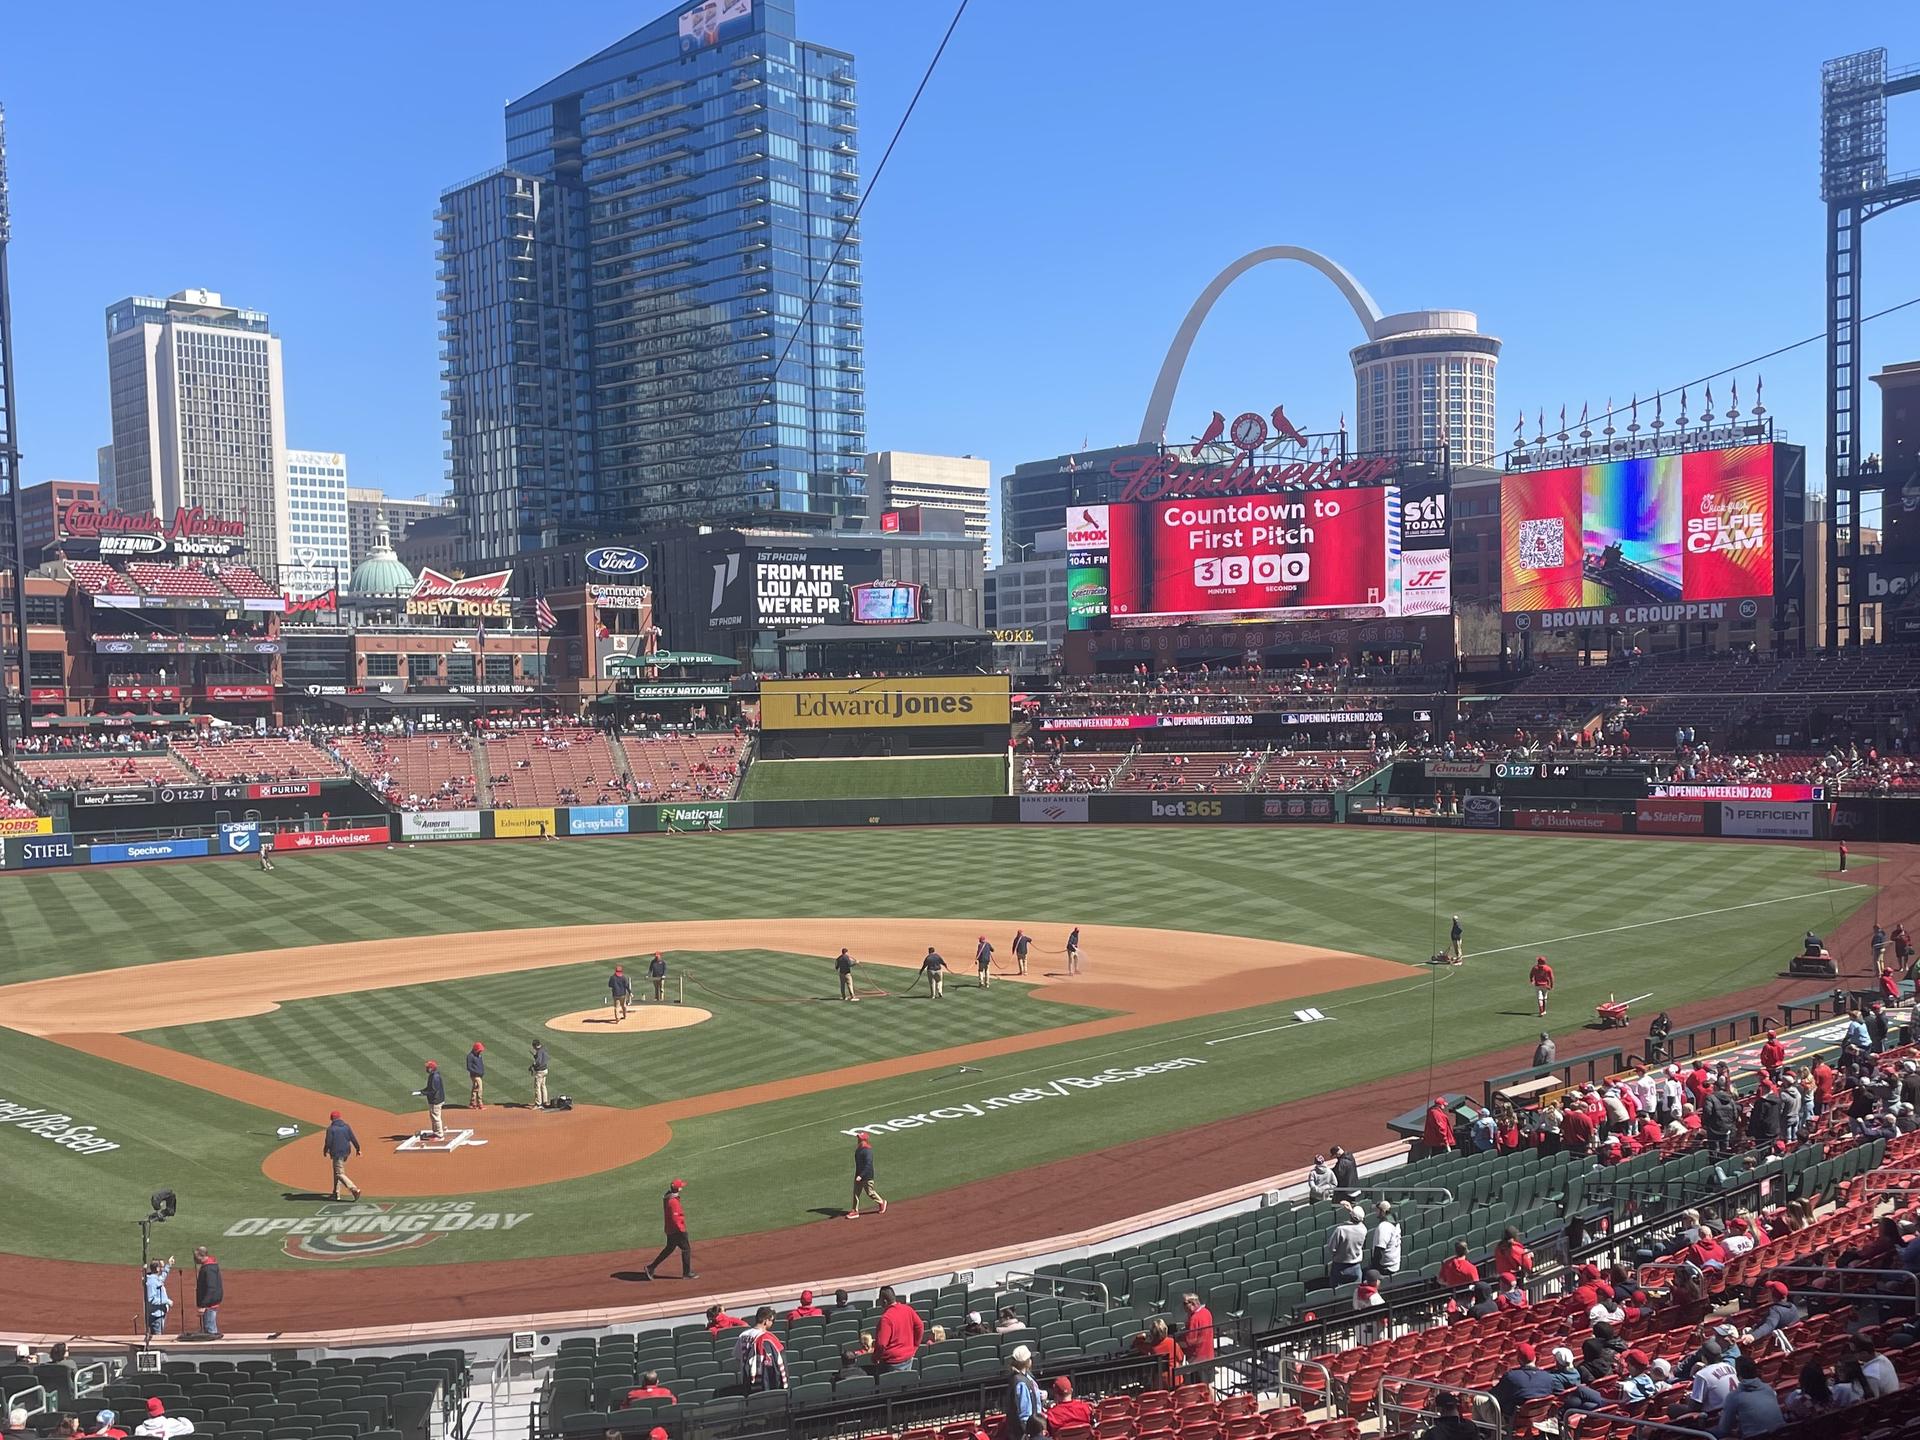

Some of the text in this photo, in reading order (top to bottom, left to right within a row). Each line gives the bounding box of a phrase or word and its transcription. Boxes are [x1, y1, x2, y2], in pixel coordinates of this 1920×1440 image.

[1528, 426, 1746, 464] WORLD CHAMPIONS
[1110, 452, 1399, 501] Budweiser
[1164, 499, 1341, 527] Countdown to
[1404, 494, 1445, 521] stl
[64, 501, 244, 540] Cardinals Nation
[1404, 520, 1445, 530] TODAY
[1687, 513, 1763, 533] SELFIE
[1068, 530, 1107, 542] KMOX
[1188, 523, 1315, 550] First Pitch
[1687, 527, 1763, 554] CAM
[100, 537, 155, 550] HOFFMANN
[174, 542, 230, 555] ROOFTOP
[599, 549, 637, 570] Ford
[757, 552, 807, 562] 1ST PHORM
[1069, 556, 1108, 565] 104.1 FM
[757, 564, 844, 581] FROM THE
[411, 579, 509, 599] Budweiser
[591, 584, 649, 599] Community
[758, 580, 832, 597] LOU AND
[596, 595, 642, 607] America
[757, 597, 814, 614] WE'RE
[406, 601, 512, 617] BREW HOUSE
[1071, 606, 1108, 615] POWER
[1541, 603, 1723, 628] BROWN & CROUPPEN
[986, 629, 1034, 643] MOKE
[676, 686, 725, 697] NATIONAL
[794, 689, 974, 719] Edward Jones
[1054, 718, 1130, 728] OPENING WEEKEND 2026
[1173, 715, 1253, 726] OPENING WEEKEND 2026
[1299, 712, 1383, 723] OPENING WEEKEND 2026
[1510, 766, 1535, 777] 12:37
[177, 790, 204, 800] 12:37
[271, 785, 307, 794] PURINA
[1669, 785, 1773, 799] OPENING WEEKEND 2026
[84, 796, 106, 805] Mercy
[1471, 799, 1492, 810] Ford
[675, 807, 724, 820] National
[1151, 800, 1222, 817] bet365
[1367, 815, 1427, 825] BUSCH STADIUM
[1547, 815, 1605, 827] Budweiser
[1738, 810, 1810, 821] PERFICIENT
[222, 822, 256, 832] CarShield
[422, 820, 450, 828] Ameren
[501, 819, 527, 828] Edward
[314, 833, 371, 845] Budweiser
[23, 844, 72, 859] STIFEL
[128, 845, 169, 857] Spectrum
[394, 1201, 476, 1214] 2026
[223, 1212, 534, 1237] OPENING DAY
